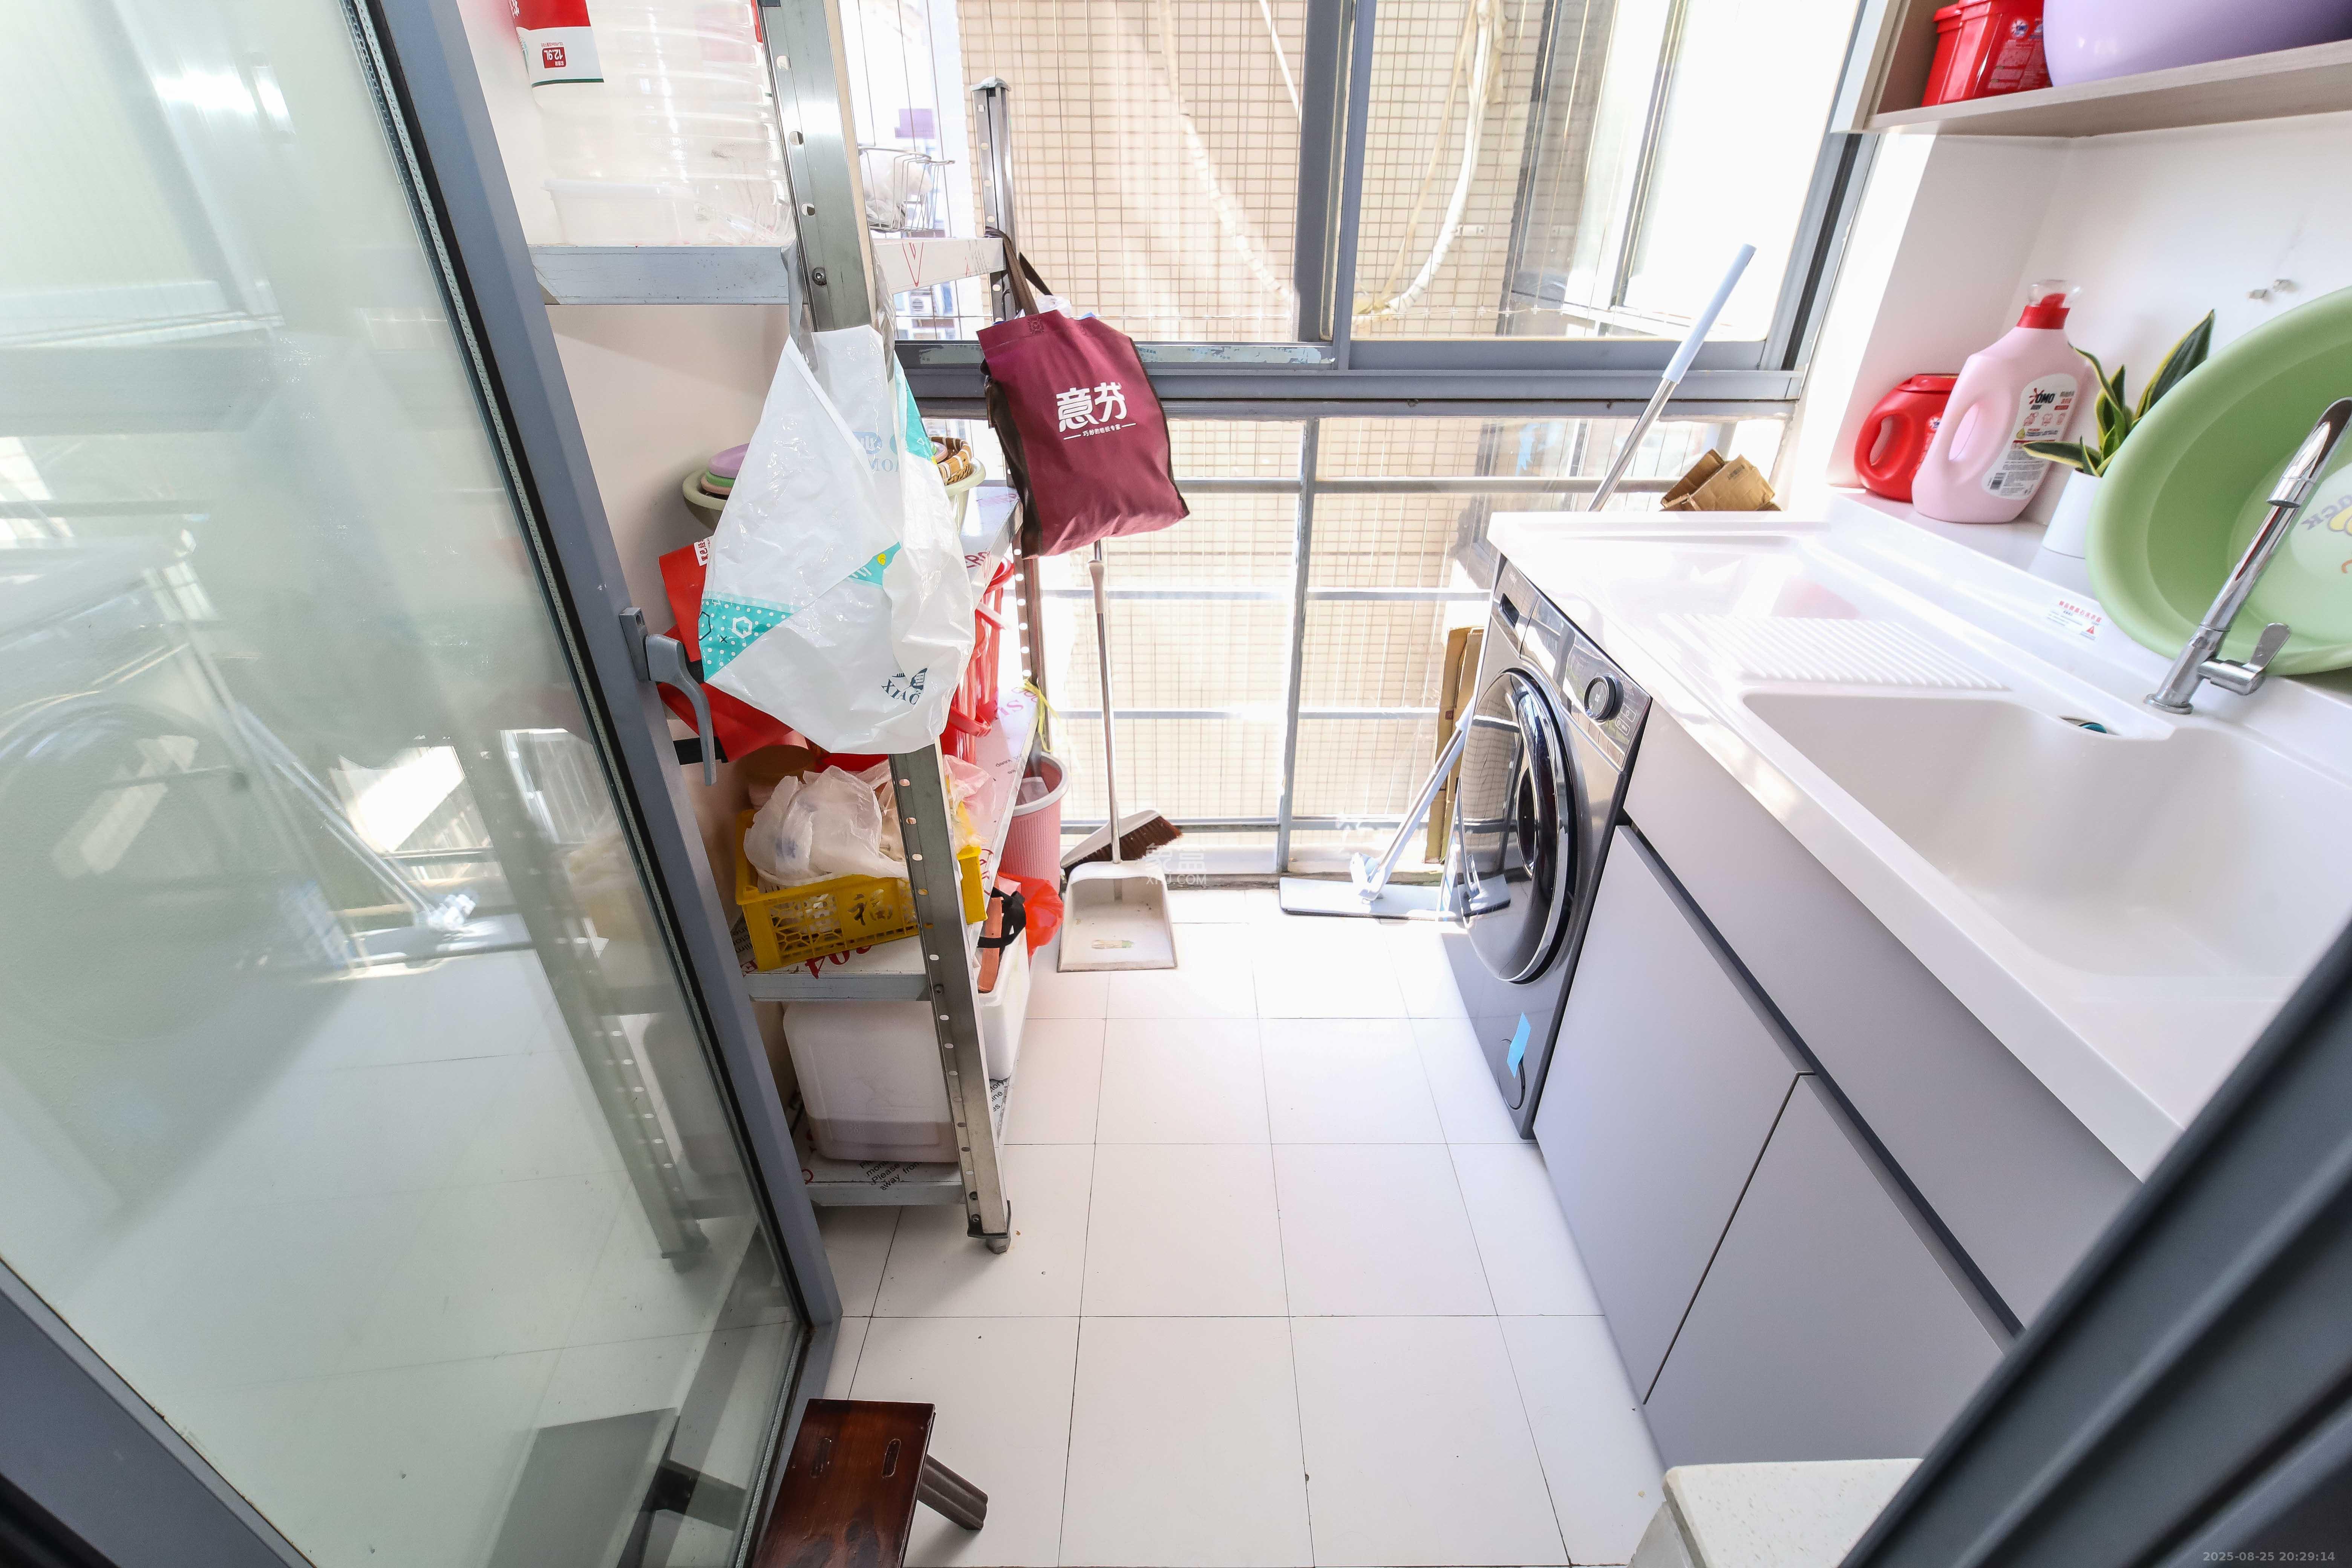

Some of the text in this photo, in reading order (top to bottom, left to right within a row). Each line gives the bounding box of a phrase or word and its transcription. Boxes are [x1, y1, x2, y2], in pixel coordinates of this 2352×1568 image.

[544, 49, 563, 61] 12.9L
[2035, 392, 2055, 403] OMO
[1056, 382, 1127, 433] 意芬
[847, 888, 893, 926] 福
[880, 1173, 900, 1191] away
